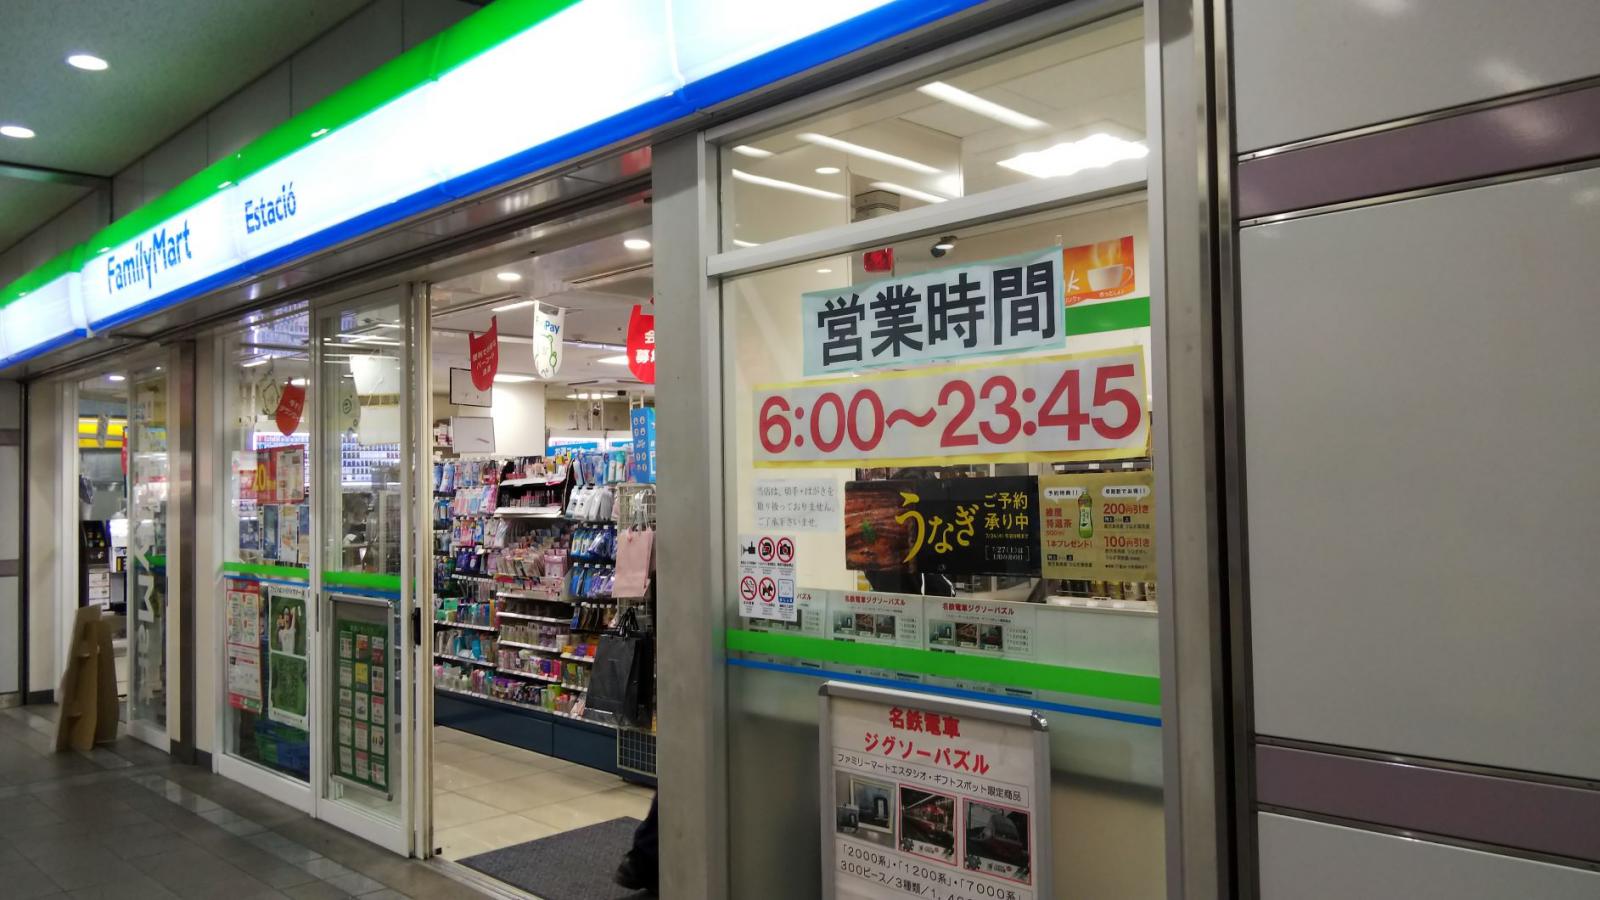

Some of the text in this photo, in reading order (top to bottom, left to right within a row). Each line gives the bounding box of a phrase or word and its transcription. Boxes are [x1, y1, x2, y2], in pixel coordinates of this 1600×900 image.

[244, 182, 297, 234] Estació
[107, 220, 192, 294] FamilyMart
[817, 260, 1056, 366] 営業時間
[759, 364, 1141, 454] 6:00~23:45
[983, 491, 1028, 510] ご予約
[984, 512, 1029, 531] 承り中
[895, 491, 980, 564] うなぎ
[888, 706, 961, 739] 名鉄電車
[864, 732, 990, 775] ジグソーパズル
